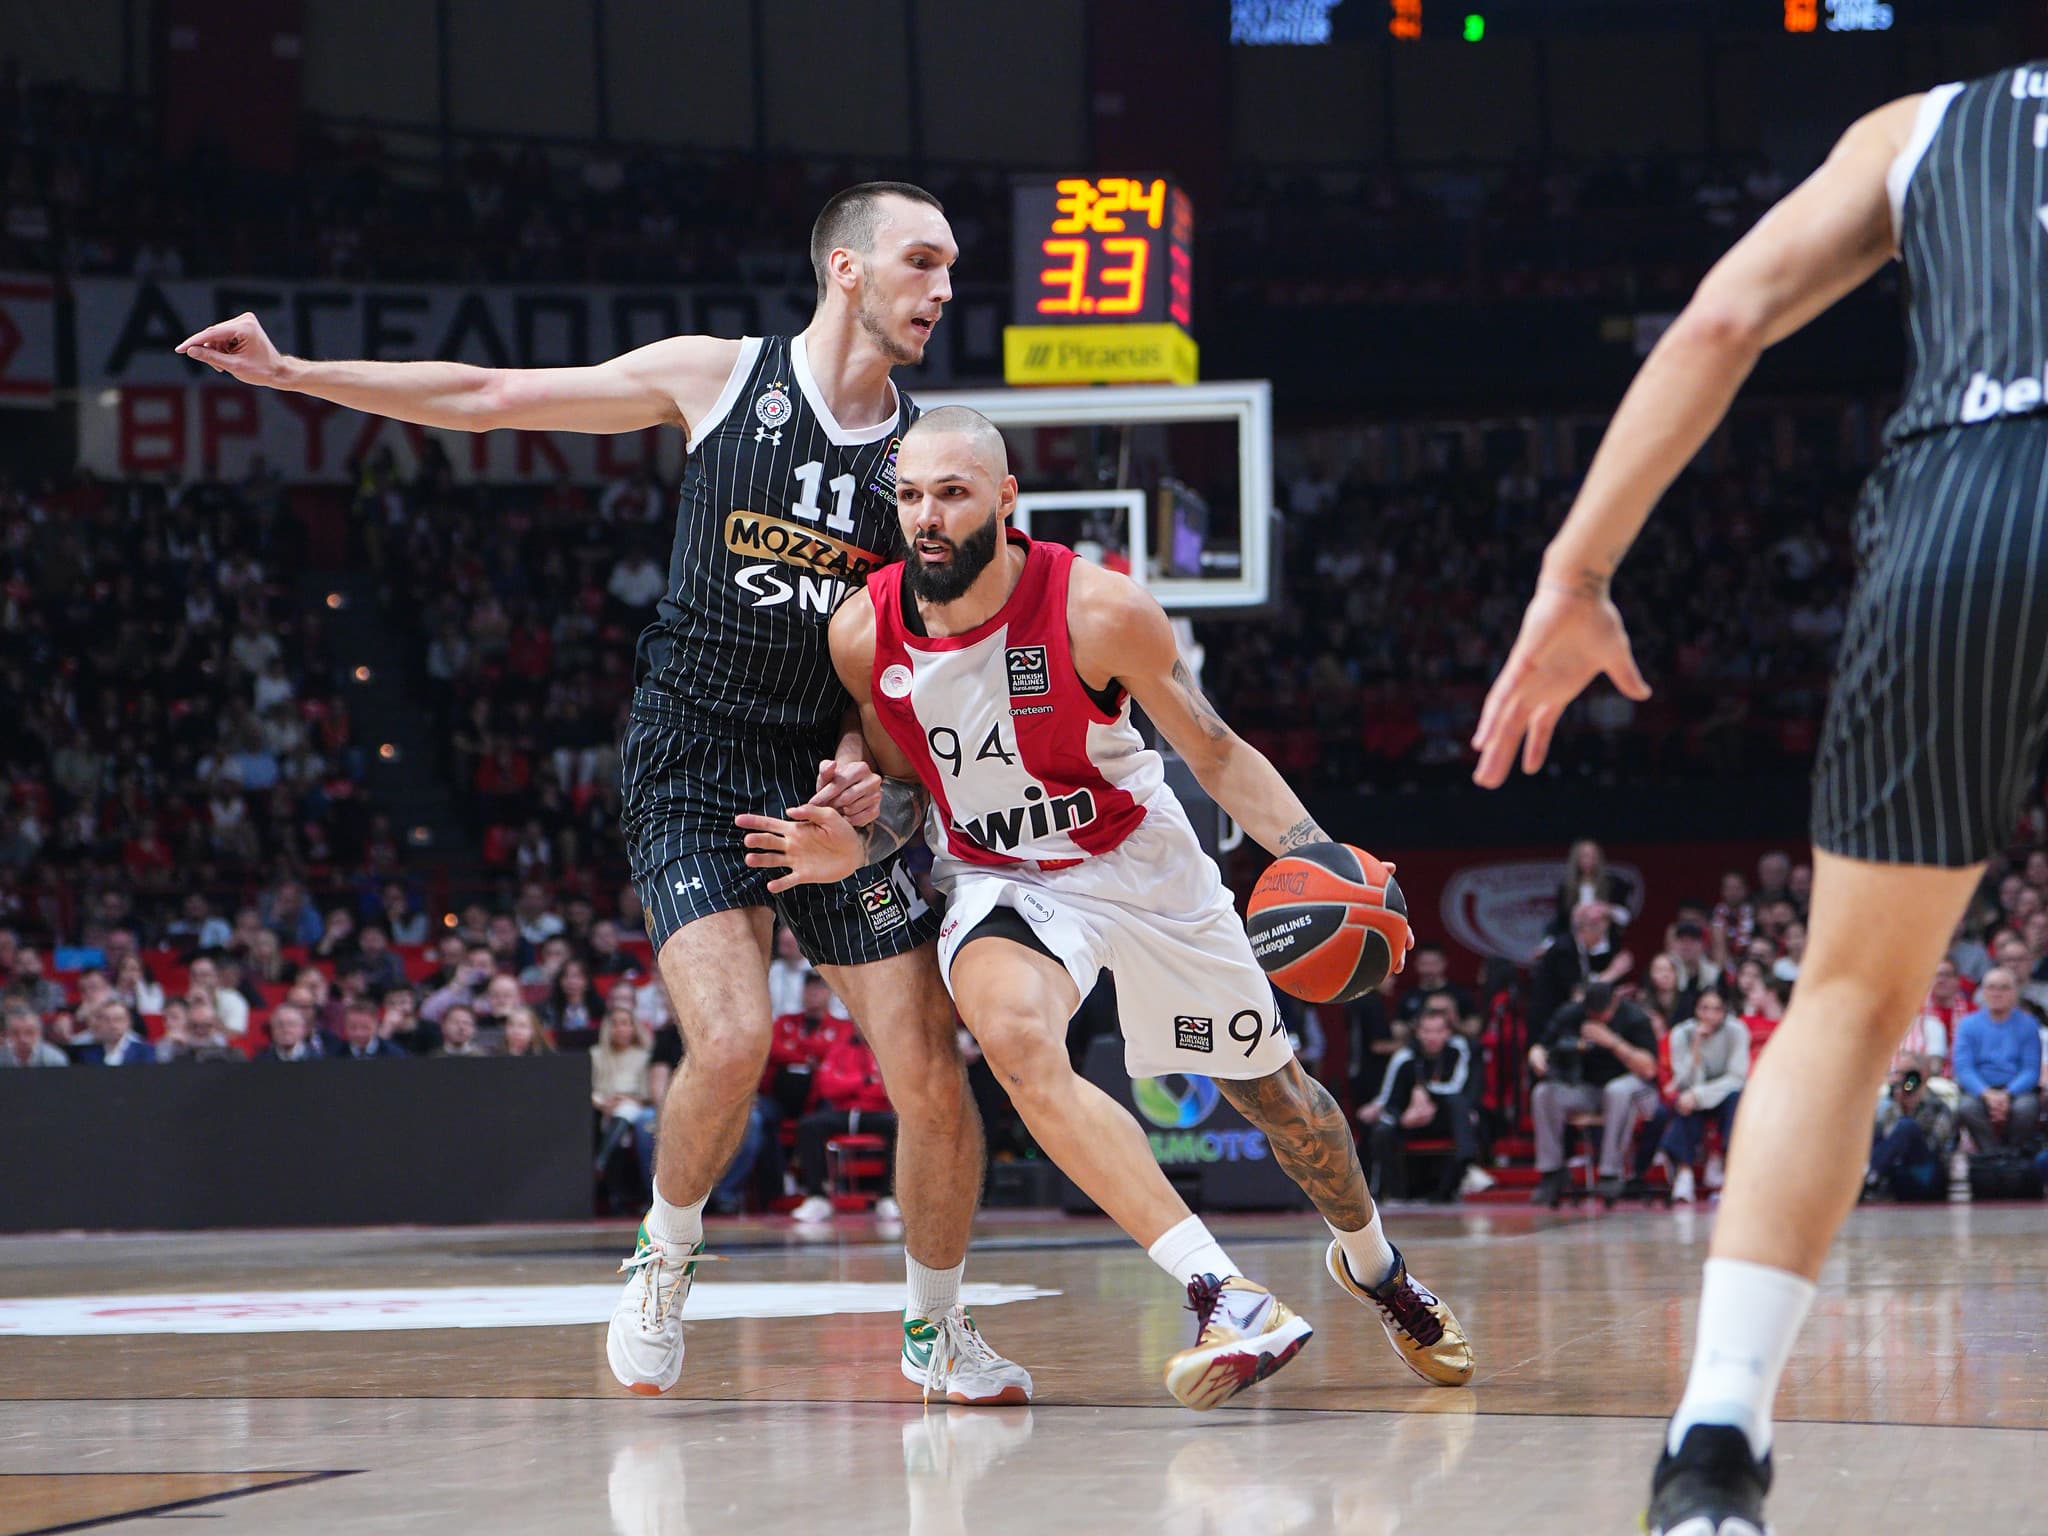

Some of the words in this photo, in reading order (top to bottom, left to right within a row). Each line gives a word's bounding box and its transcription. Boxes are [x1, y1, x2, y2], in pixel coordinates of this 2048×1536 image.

[1051, 178, 1167, 234] 3:24
[1036, 237, 1150, 315] 3.3
[792, 460, 856, 534] 11
[730, 518, 884, 578] MOZZAR
[1009, 650, 1043, 671] 25
[1012, 673, 1044, 681] TURKISH
[1012, 679, 1045, 687] AIRLINES
[1009, 705, 1054, 716] oneteam
[928, 721, 1017, 778] 94
[953, 785, 1095, 851] win
[870, 904, 899, 920] TURKISH
[872, 910, 901, 926] AIRLINES
[1271, 914, 1313, 938] AIRLINES
